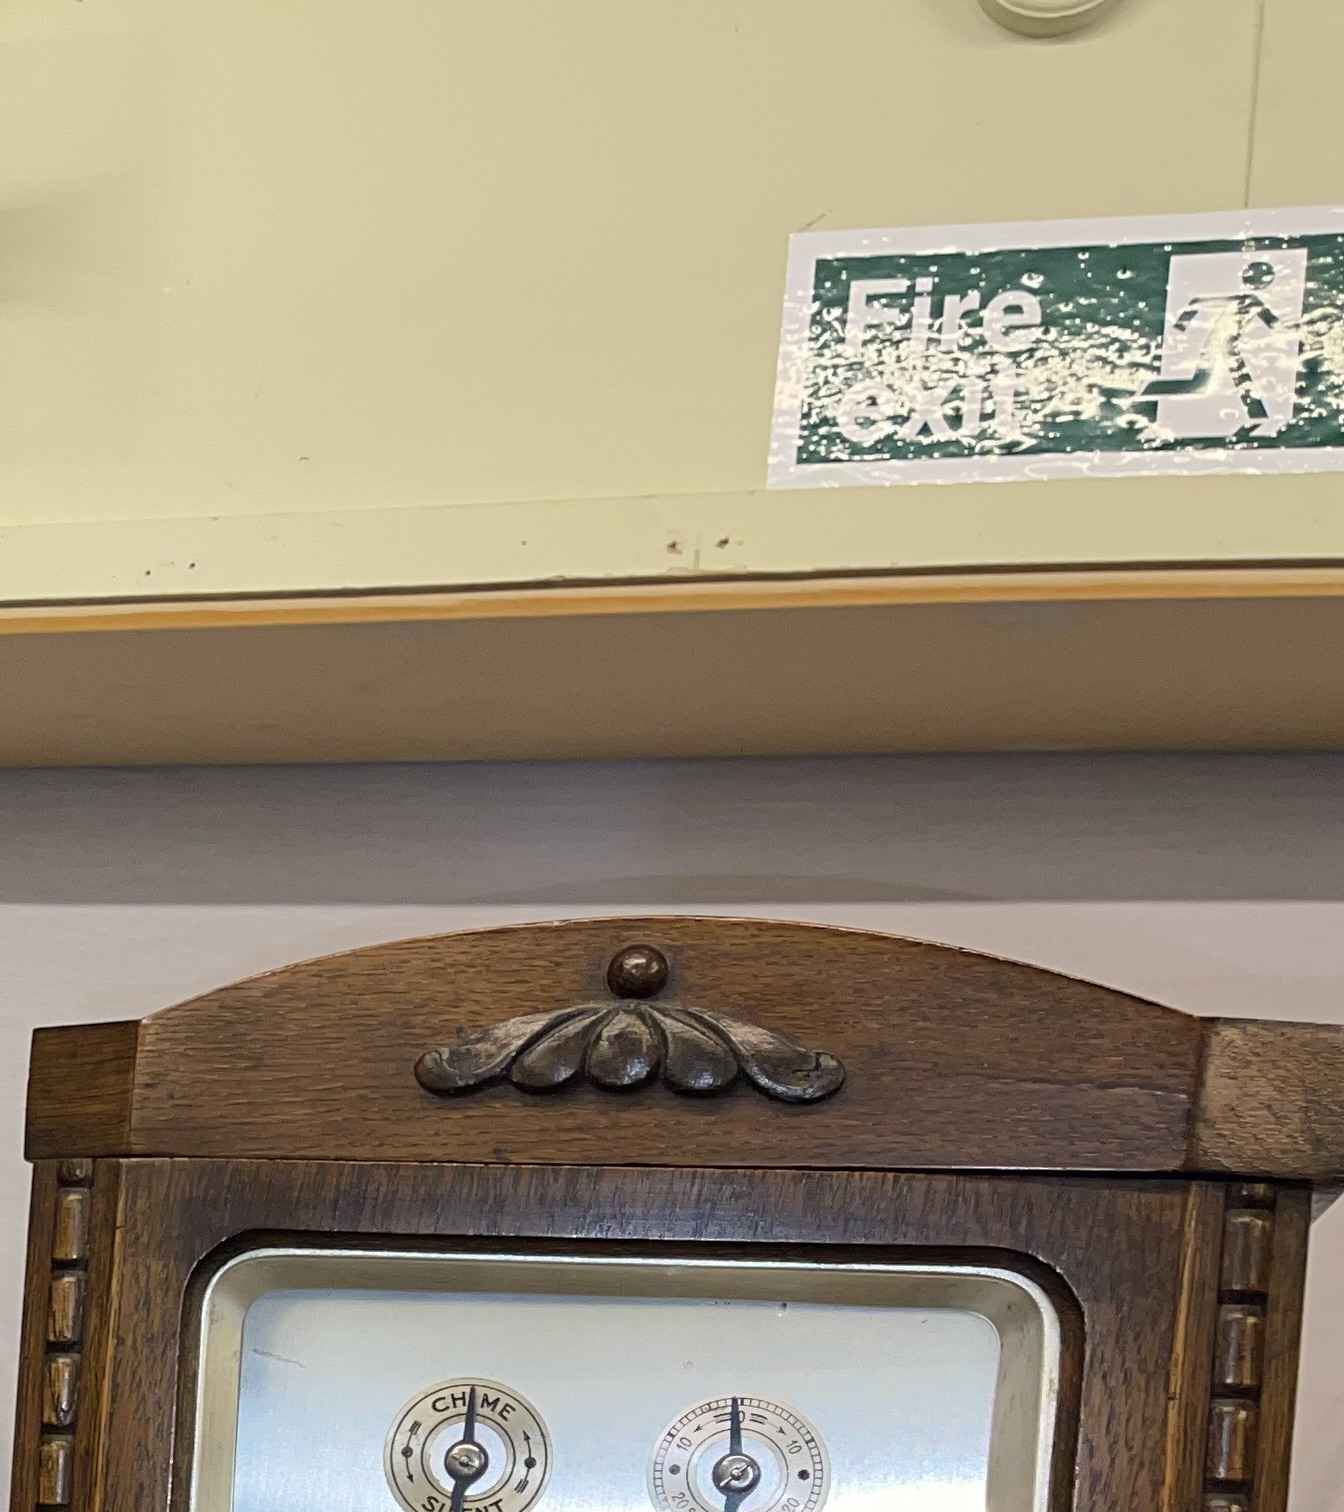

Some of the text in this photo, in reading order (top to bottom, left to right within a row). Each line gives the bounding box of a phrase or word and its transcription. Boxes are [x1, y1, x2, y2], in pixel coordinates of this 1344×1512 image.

[844, 276, 1043, 354] Fire
[430, 1391, 516, 1422] CHME
[675, 1436, 693, 1452] 10
[785, 1439, 802, 1456] 10
